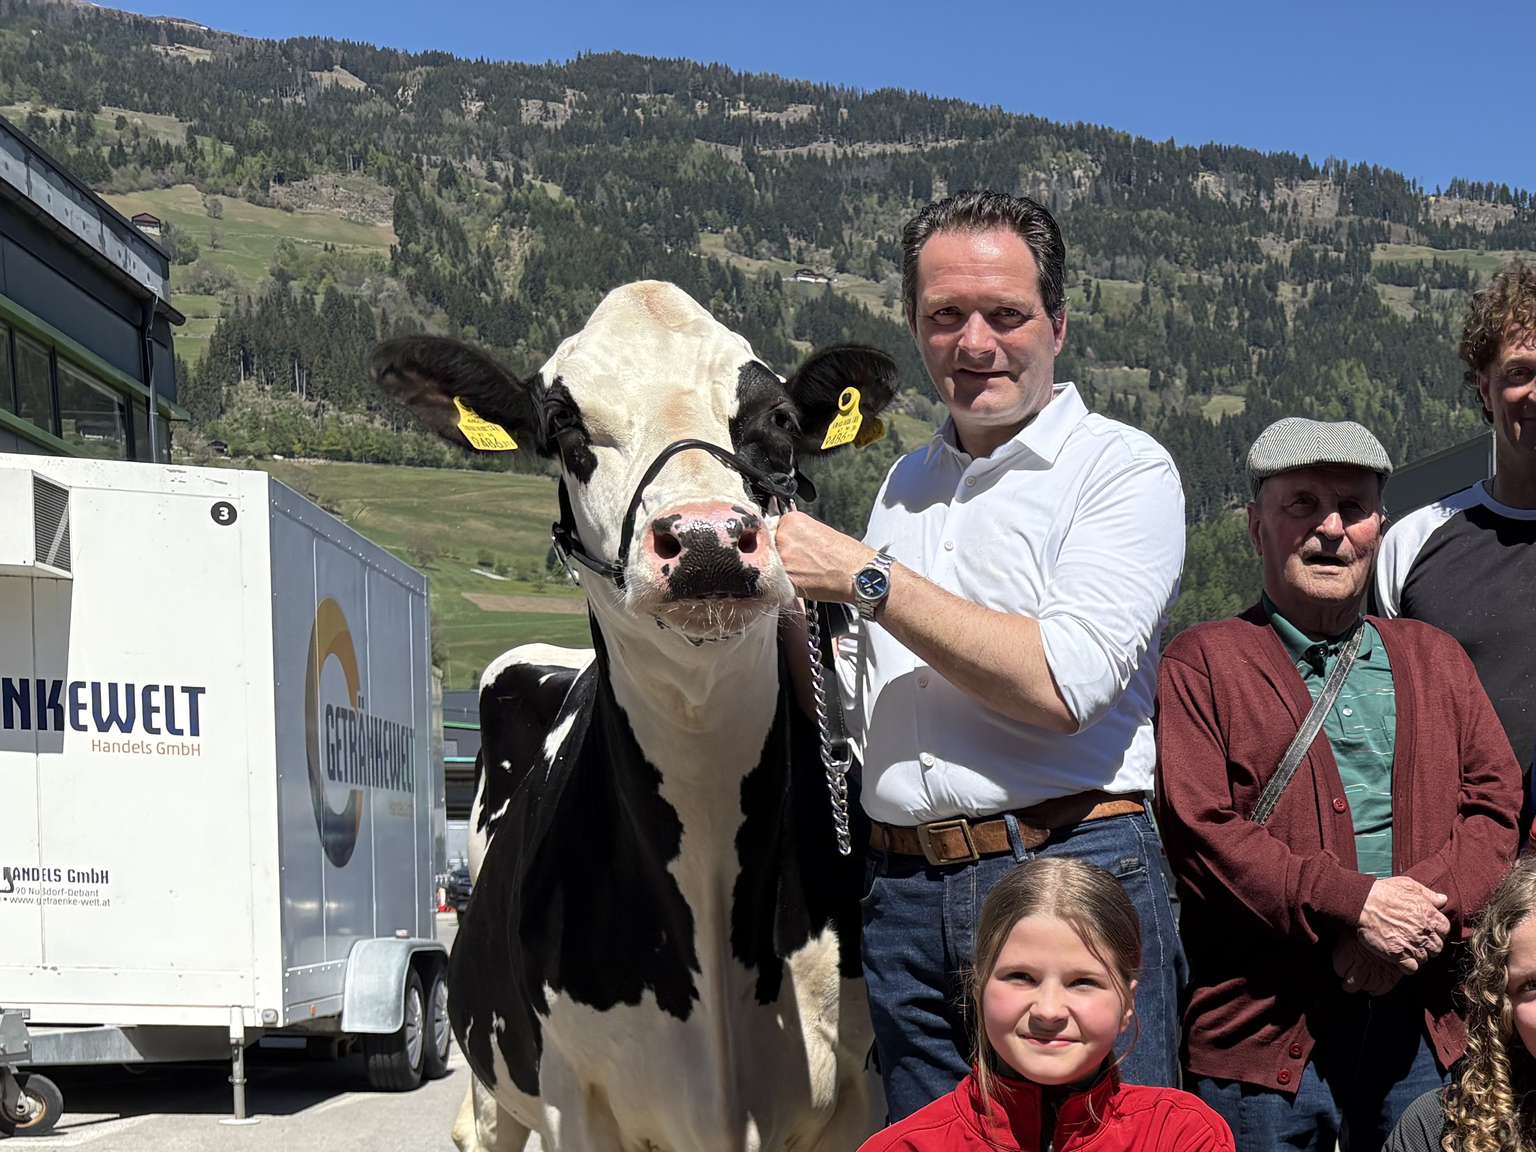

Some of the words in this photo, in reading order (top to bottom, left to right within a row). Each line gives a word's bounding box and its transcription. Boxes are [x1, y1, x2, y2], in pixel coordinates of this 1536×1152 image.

[219, 506, 230, 520] 3
[91, 739, 152, 756] Handels
[156, 741, 201, 757] GmbH
[325, 695, 415, 794] GETRÄNKEWELT
[67, 867, 109, 885] GmbH
